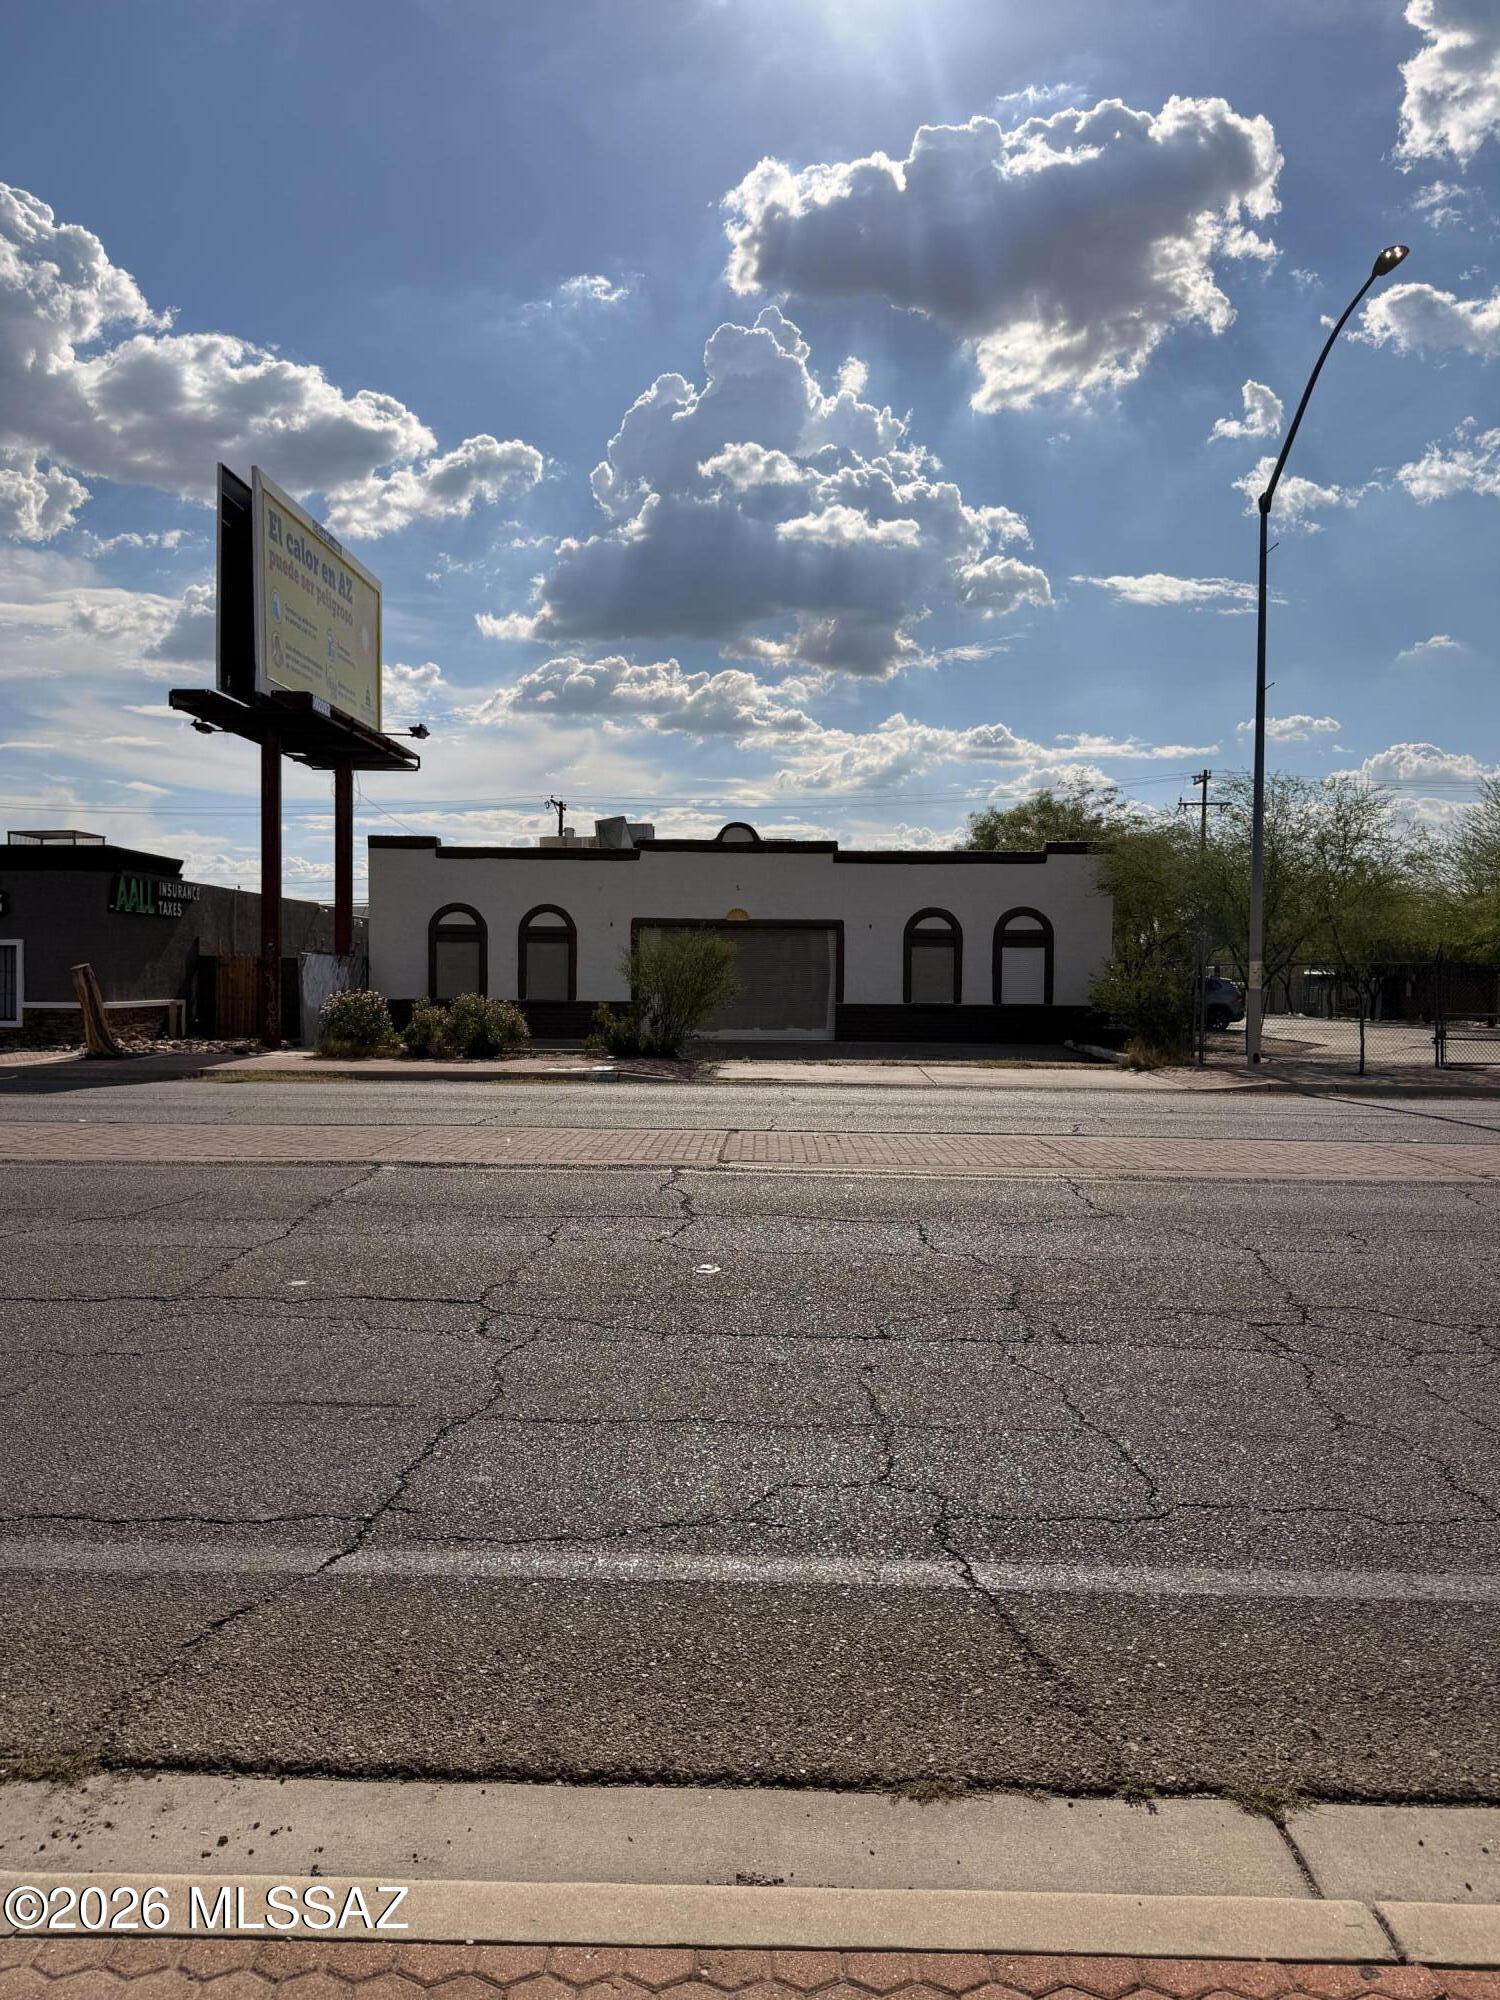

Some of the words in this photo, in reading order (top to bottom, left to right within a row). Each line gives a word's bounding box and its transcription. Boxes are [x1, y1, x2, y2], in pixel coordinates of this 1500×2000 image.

[268, 508, 283, 547] El
[286, 533, 320, 577] calor
[321, 563, 337, 591] en
[338, 571, 353, 605] AZ
[269, 549, 299, 585] puede
[316, 585, 353, 626] peligroso
[115, 875, 155, 914] AALL
[159, 881, 200, 901] INSURANCE
[158, 900, 182, 917] TAXES
